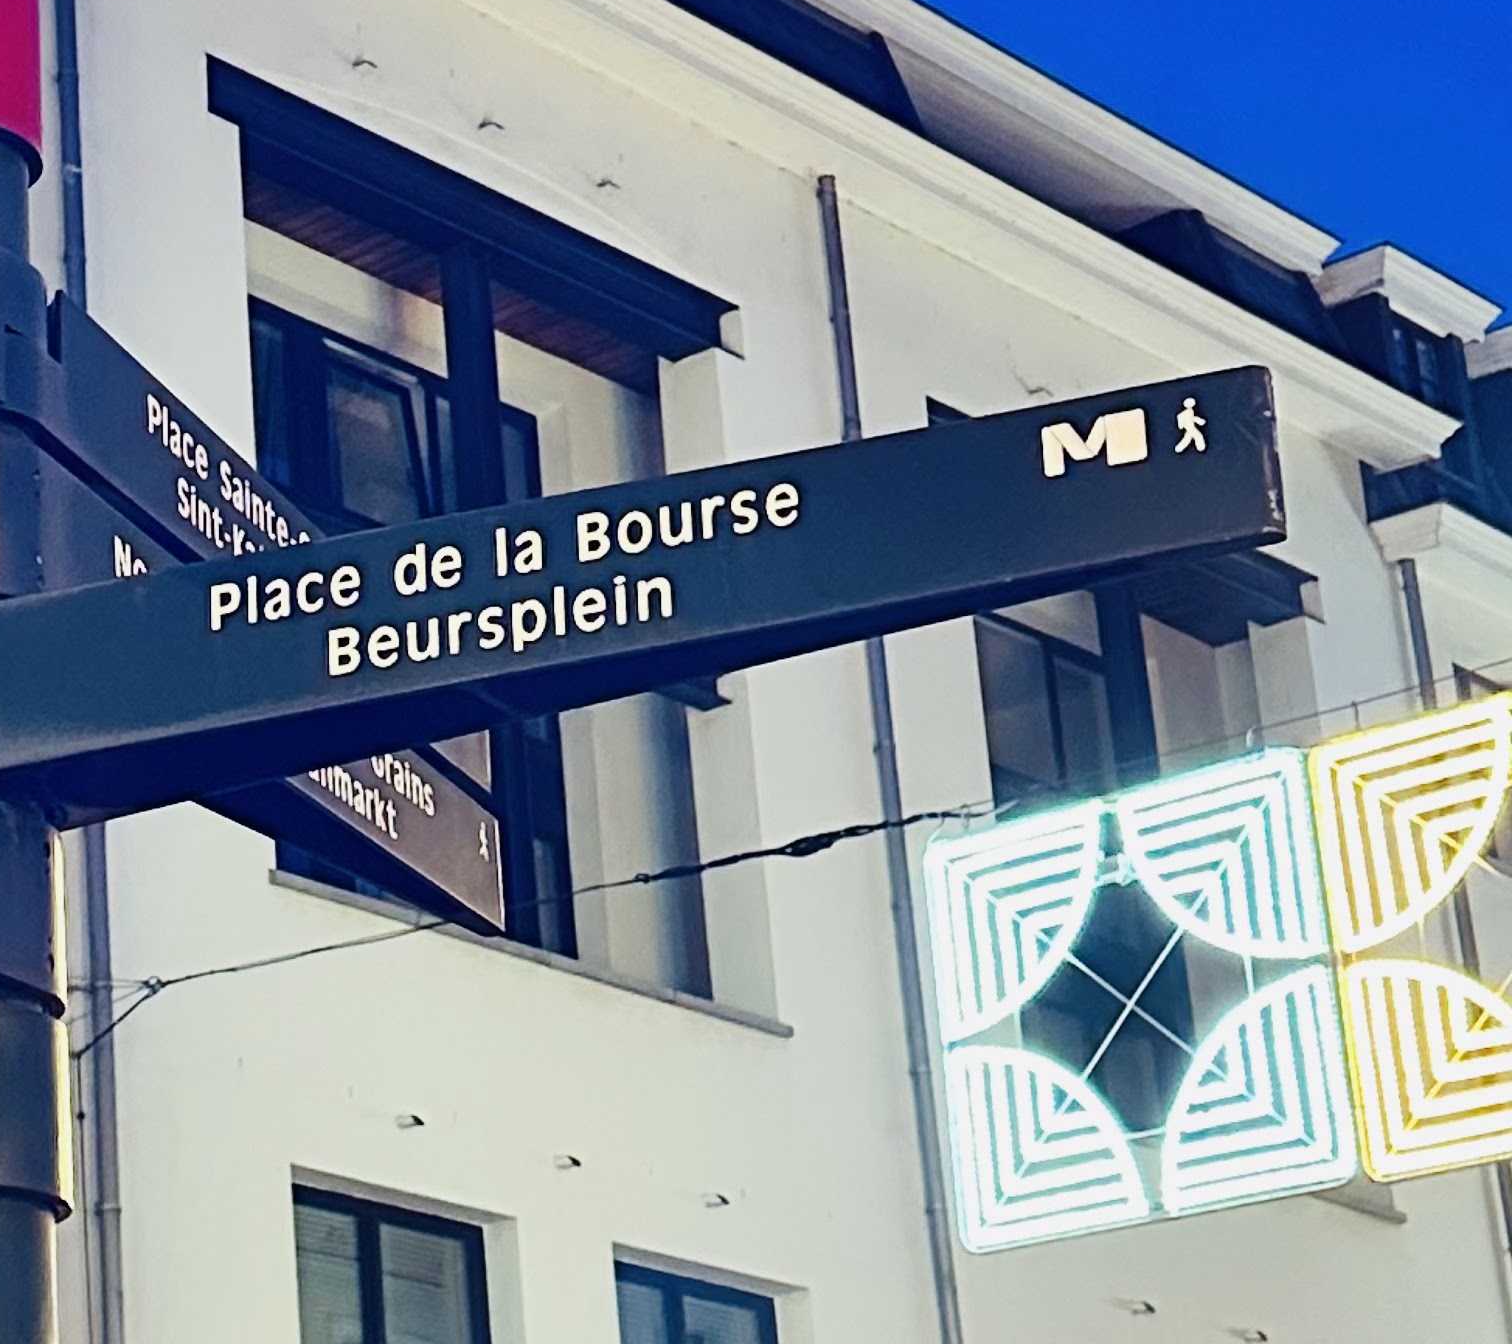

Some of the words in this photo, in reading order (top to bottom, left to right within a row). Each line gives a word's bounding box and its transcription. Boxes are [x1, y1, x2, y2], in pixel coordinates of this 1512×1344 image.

[146, 393, 209, 480] Place
[209, 564, 362, 632] Place
[393, 542, 463, 596] de
[495, 527, 544, 577] la
[575, 481, 802, 564] Bourse
[327, 570, 675, 677] Beursplein
